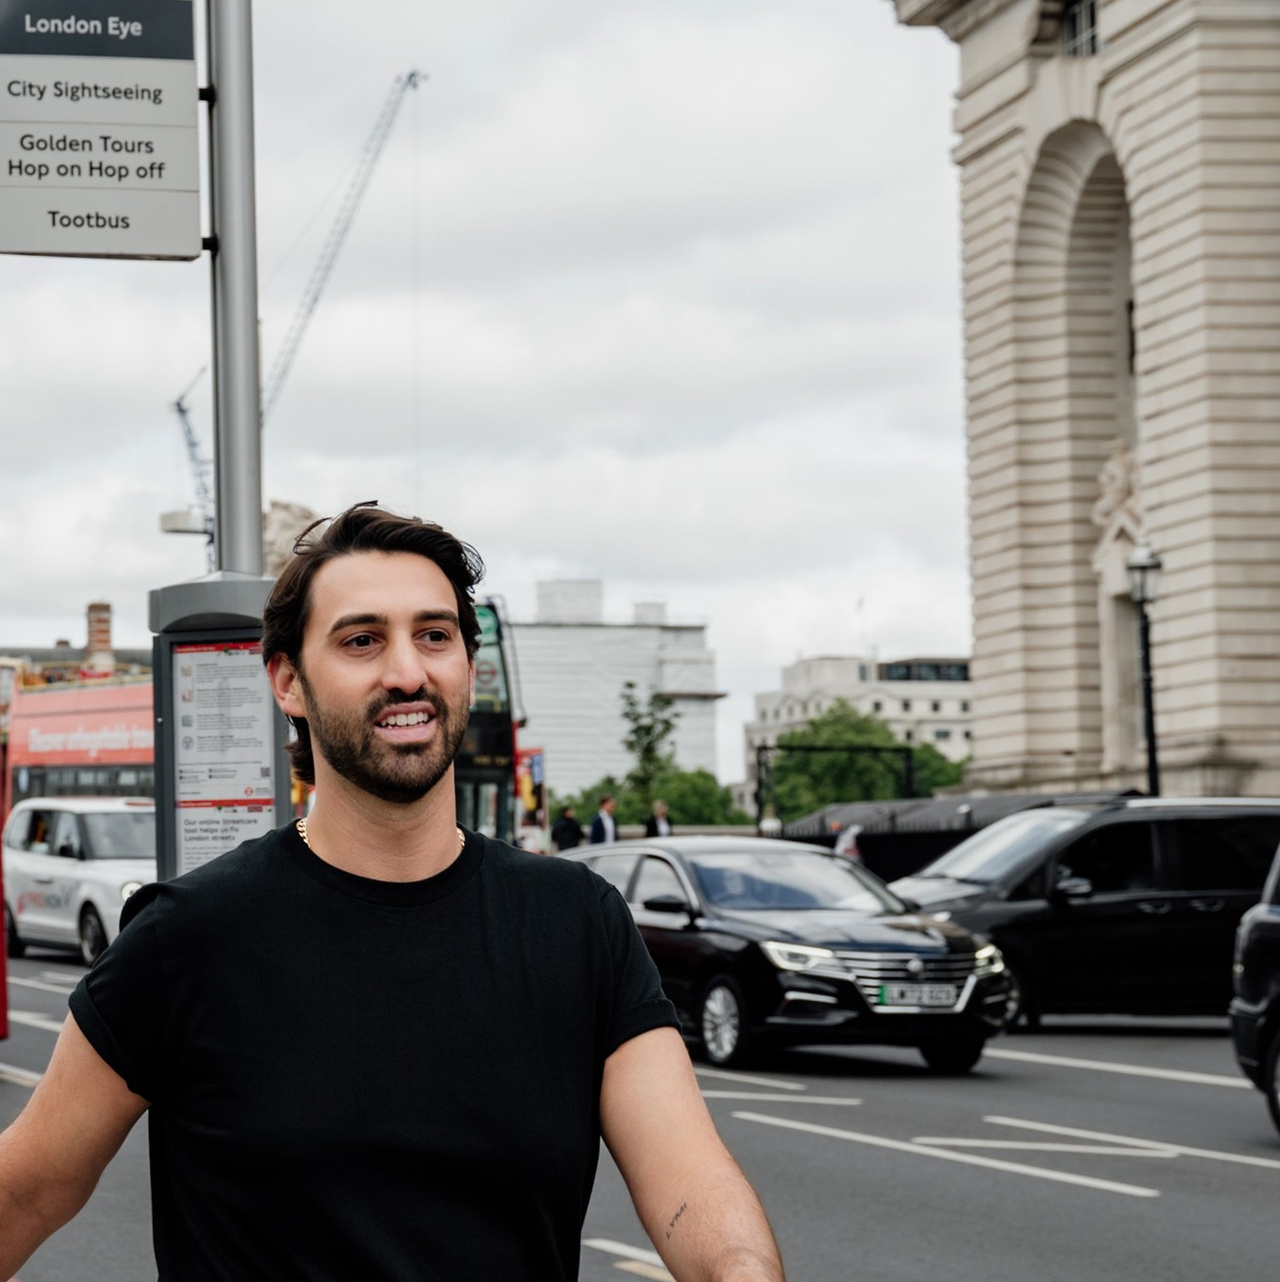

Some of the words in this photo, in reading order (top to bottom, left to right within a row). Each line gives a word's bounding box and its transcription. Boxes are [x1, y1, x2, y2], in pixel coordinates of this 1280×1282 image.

[24, 13, 102, 35] London
[107, 16, 143, 40] Eye
[6, 79, 47, 101] City
[53, 80, 163, 105] Sightseeing
[19, 133, 93, 153] Golden
[99, 135, 155, 155] Tours
[8, 159, 50, 181] Hop
[56, 163, 82, 177] on
[88, 160, 130, 183] Hop
[136, 161, 166, 180] off
[47, 210, 131, 231] Tootbus
